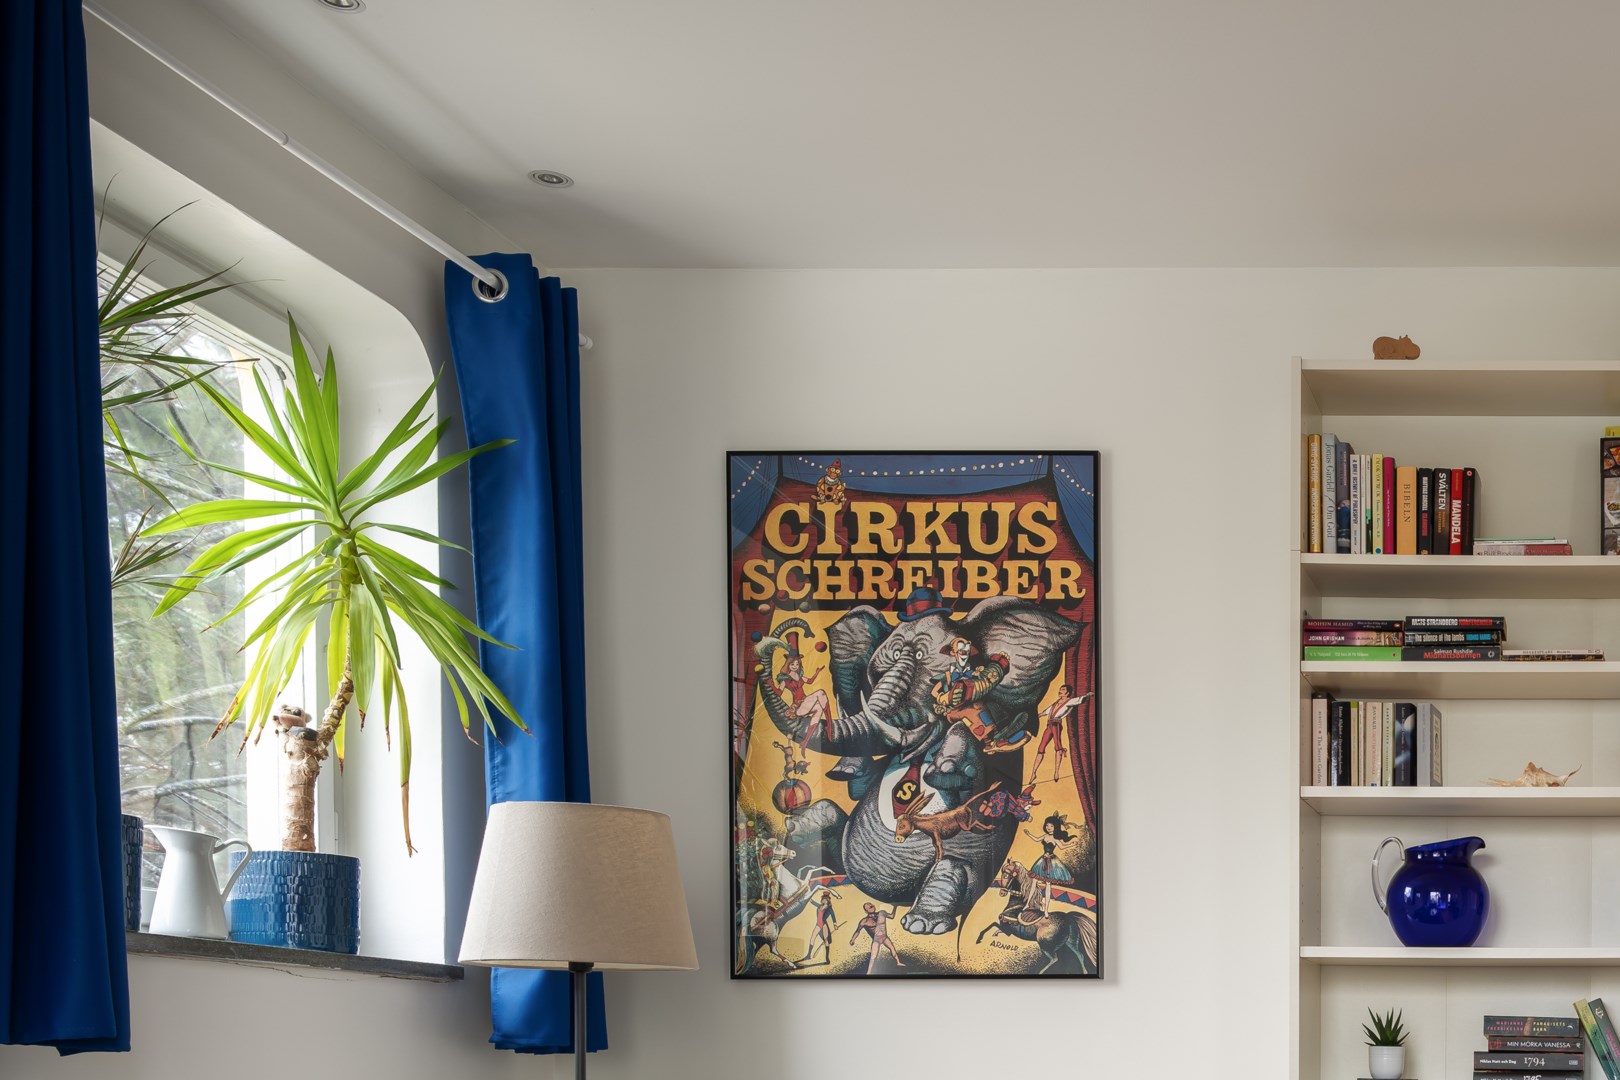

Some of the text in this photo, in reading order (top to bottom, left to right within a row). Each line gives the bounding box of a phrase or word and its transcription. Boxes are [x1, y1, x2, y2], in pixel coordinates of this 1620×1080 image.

[1325, 442, 1336, 538] Jonas Gardell Om Gud
[1403, 483, 1411, 523] BIBELN
[1438, 472, 1449, 510] SVÄLTEN
[764, 501, 1059, 555] CIRKUS
[1451, 499, 1462, 544] MANDELA
[741, 559, 1087, 601] SCHREIBER
[1423, 633, 1438, 641] silence
[1451, 633, 1465, 641] lambs
[1423, 651, 1481, 659] Midnattsbarnen
[896, 782, 917, 801] S
[989, 940, 1019, 951] ARNOLD
[1524, 1057, 1546, 1067] 1794
